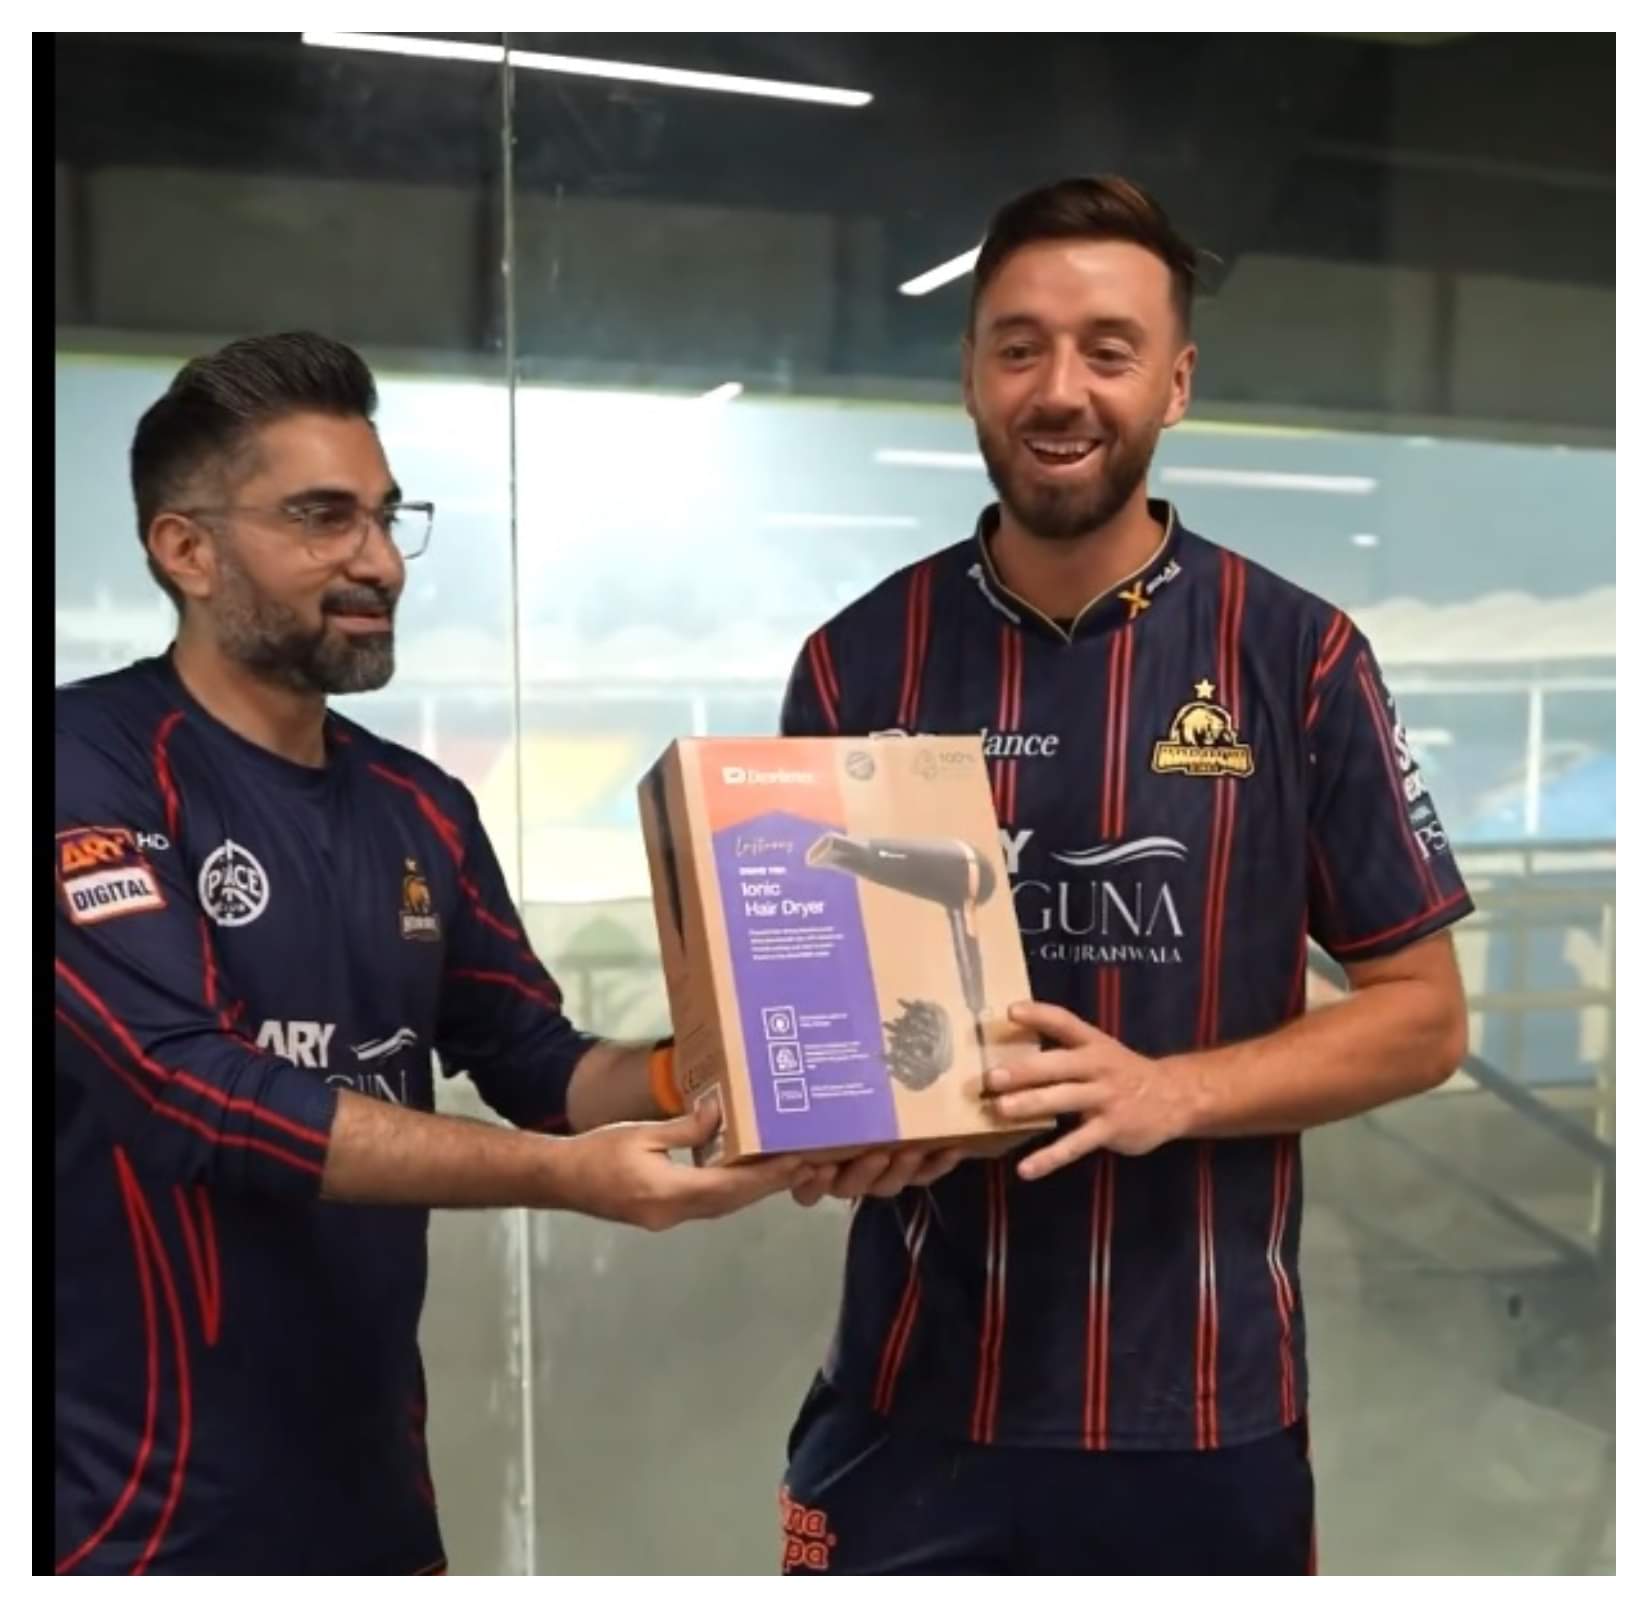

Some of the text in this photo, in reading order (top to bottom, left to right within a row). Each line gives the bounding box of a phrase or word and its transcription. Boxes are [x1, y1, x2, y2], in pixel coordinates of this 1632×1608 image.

[137, 831, 170, 850] HD
[72, 878, 152, 912] DIGITAL
[745, 899, 825, 918] Hair Dryer
[1011, 880, 1184, 938] GUNA
[255, 1020, 336, 1069] ARY
